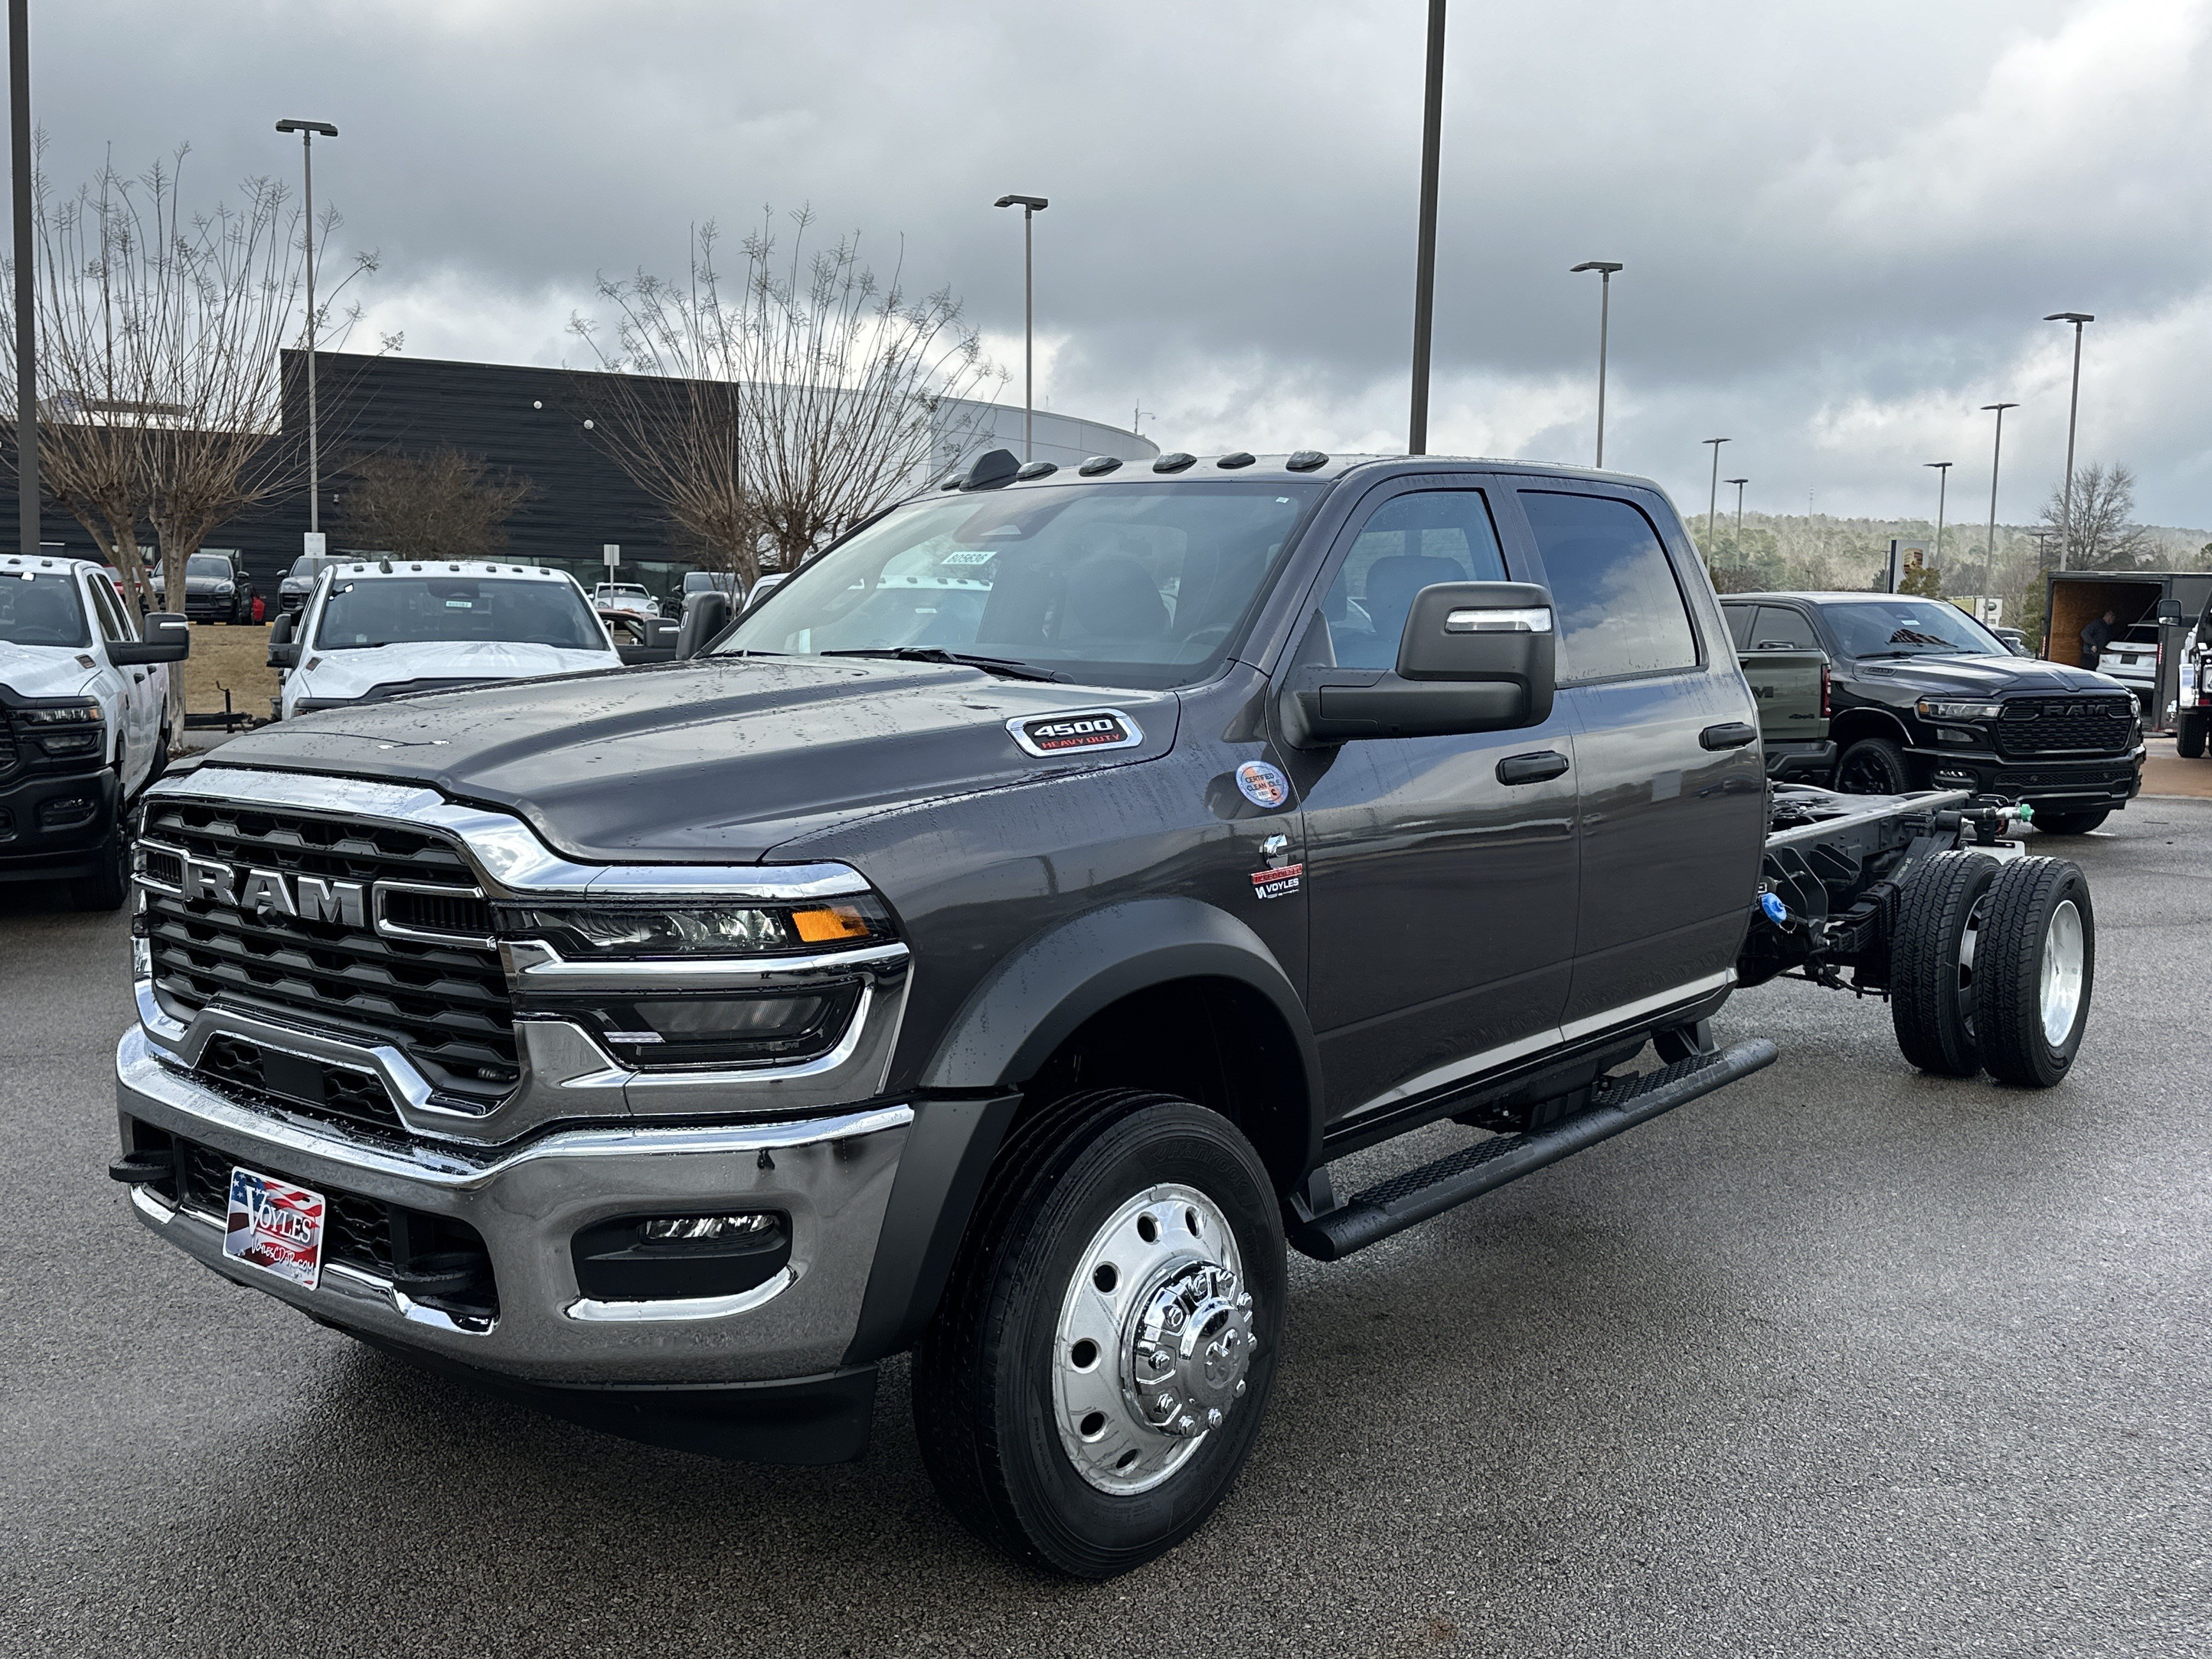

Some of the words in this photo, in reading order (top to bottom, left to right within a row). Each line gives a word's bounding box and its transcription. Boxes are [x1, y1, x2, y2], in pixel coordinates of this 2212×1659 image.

[2044, 704, 2109, 715] RAM
[1034, 719, 1114, 737] 4500
[1041, 738, 1084, 749] HEAVY
[1086, 733, 1120, 744] DUTY
[1245, 772, 1274, 783] CERTIFIED
[1247, 782, 1267, 792] CLEAN
[1267, 779, 1282, 787] IDLE
[187, 857, 365, 927] RAM
[1266, 877, 1299, 893] VOYLES
[246, 1185, 312, 1243] VOYLES
